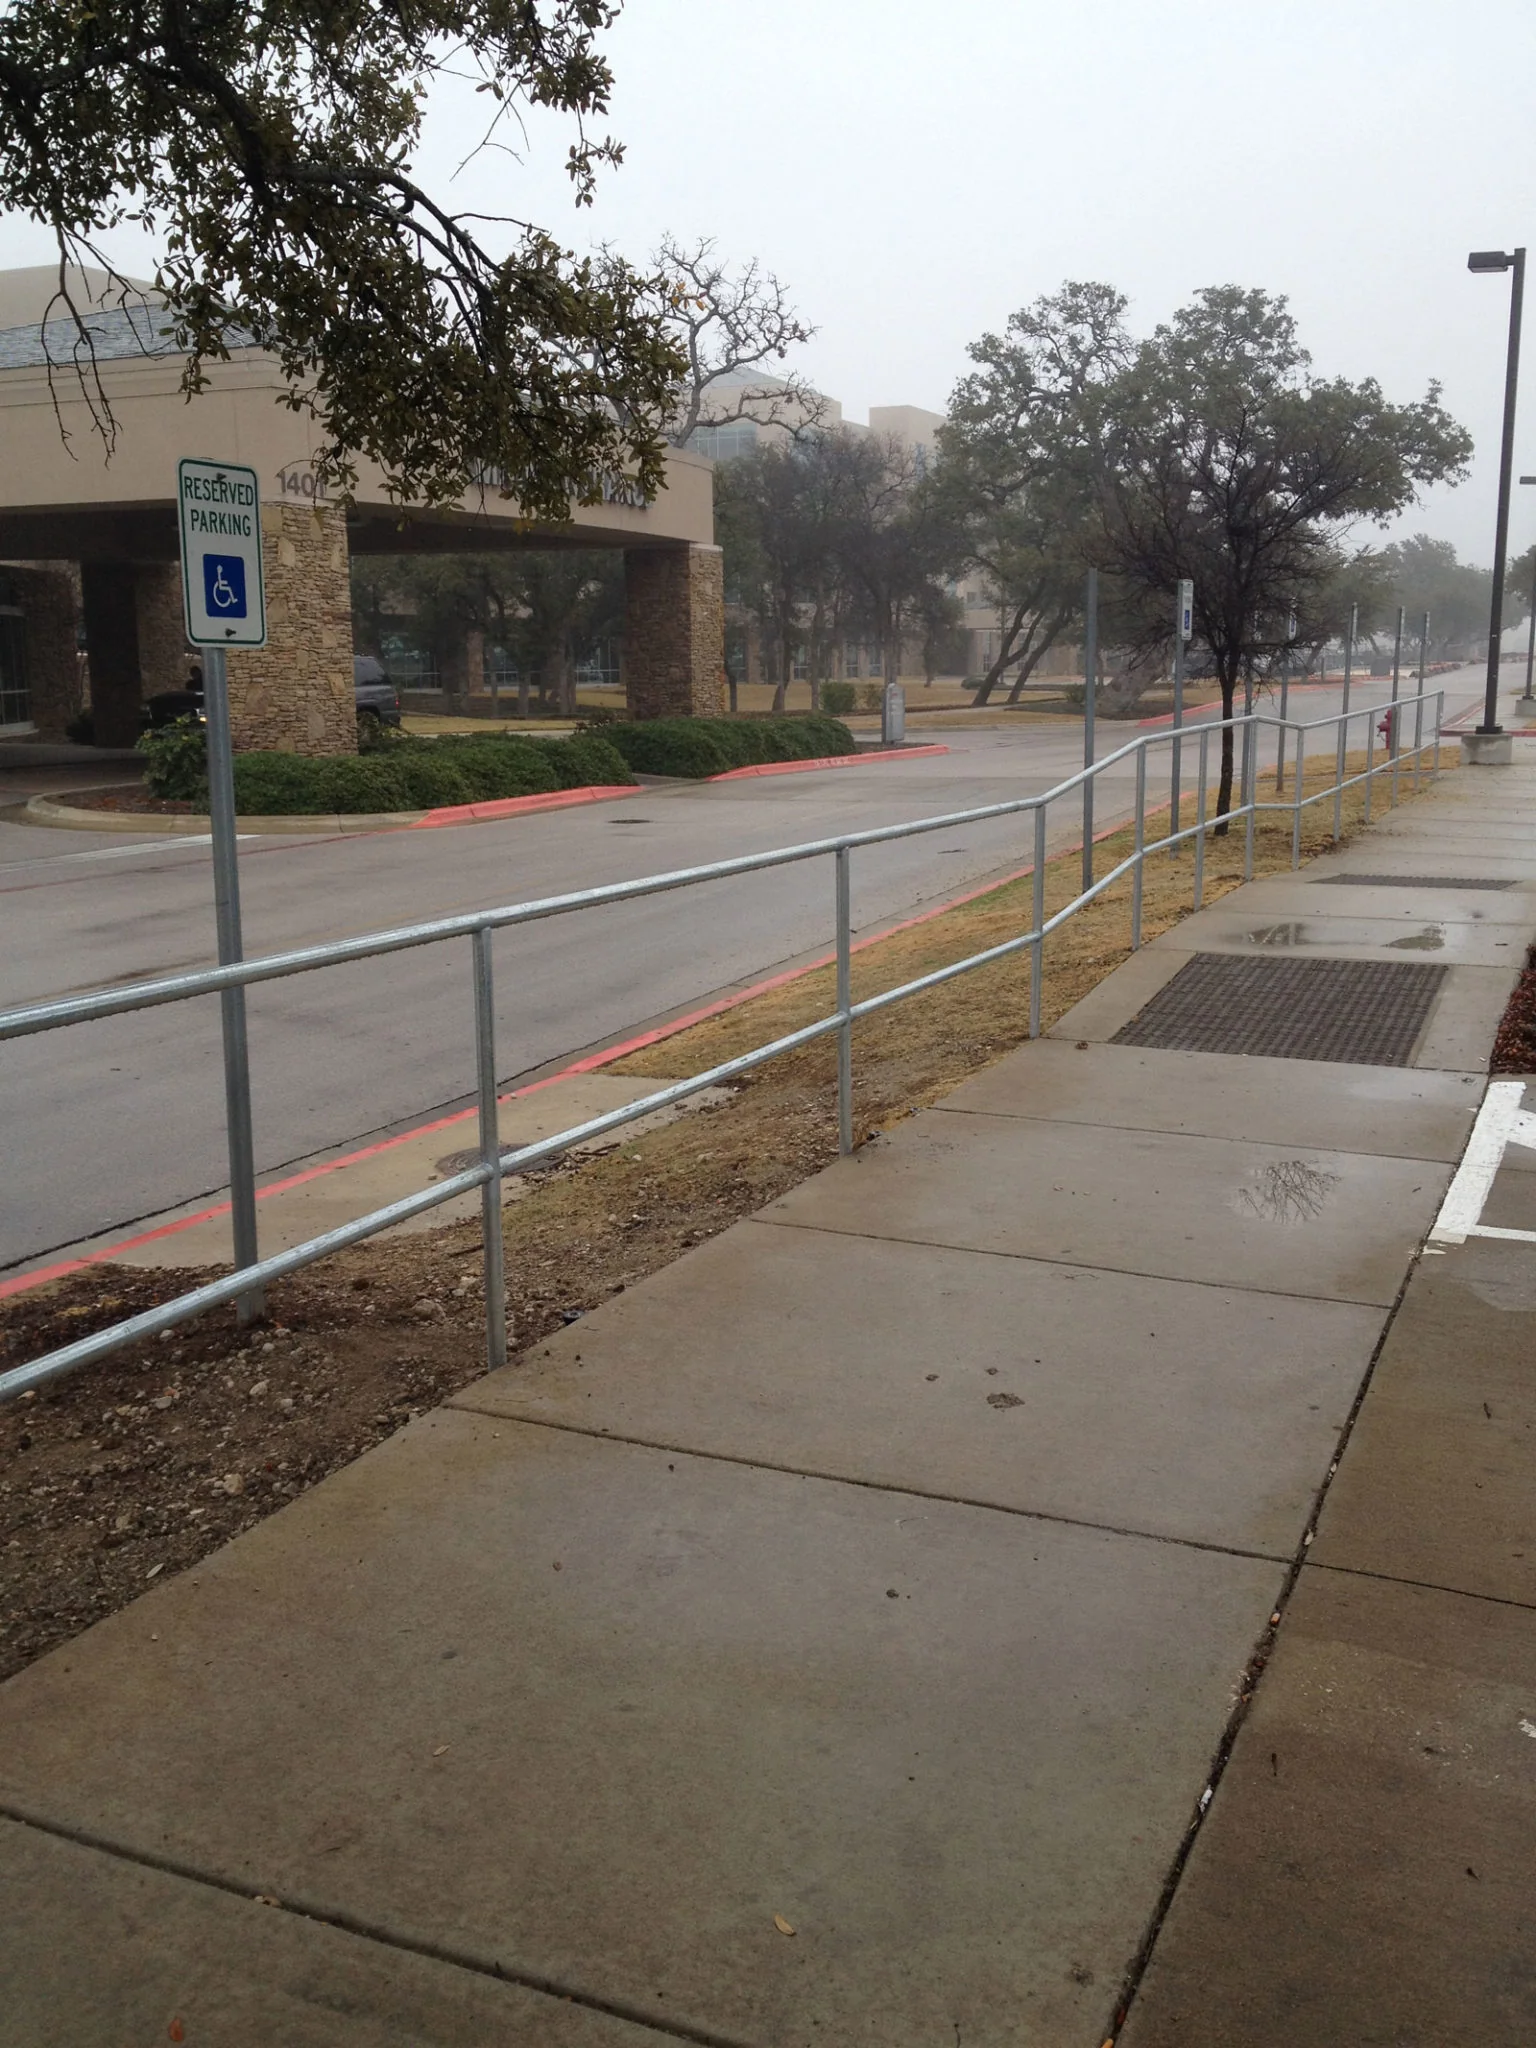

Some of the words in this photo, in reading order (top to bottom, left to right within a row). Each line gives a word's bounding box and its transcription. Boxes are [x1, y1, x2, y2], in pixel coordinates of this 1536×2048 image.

[184, 476, 254, 506] RESERVED
[276, 470, 325, 499] 1401
[191, 509, 251, 537] PARKING
